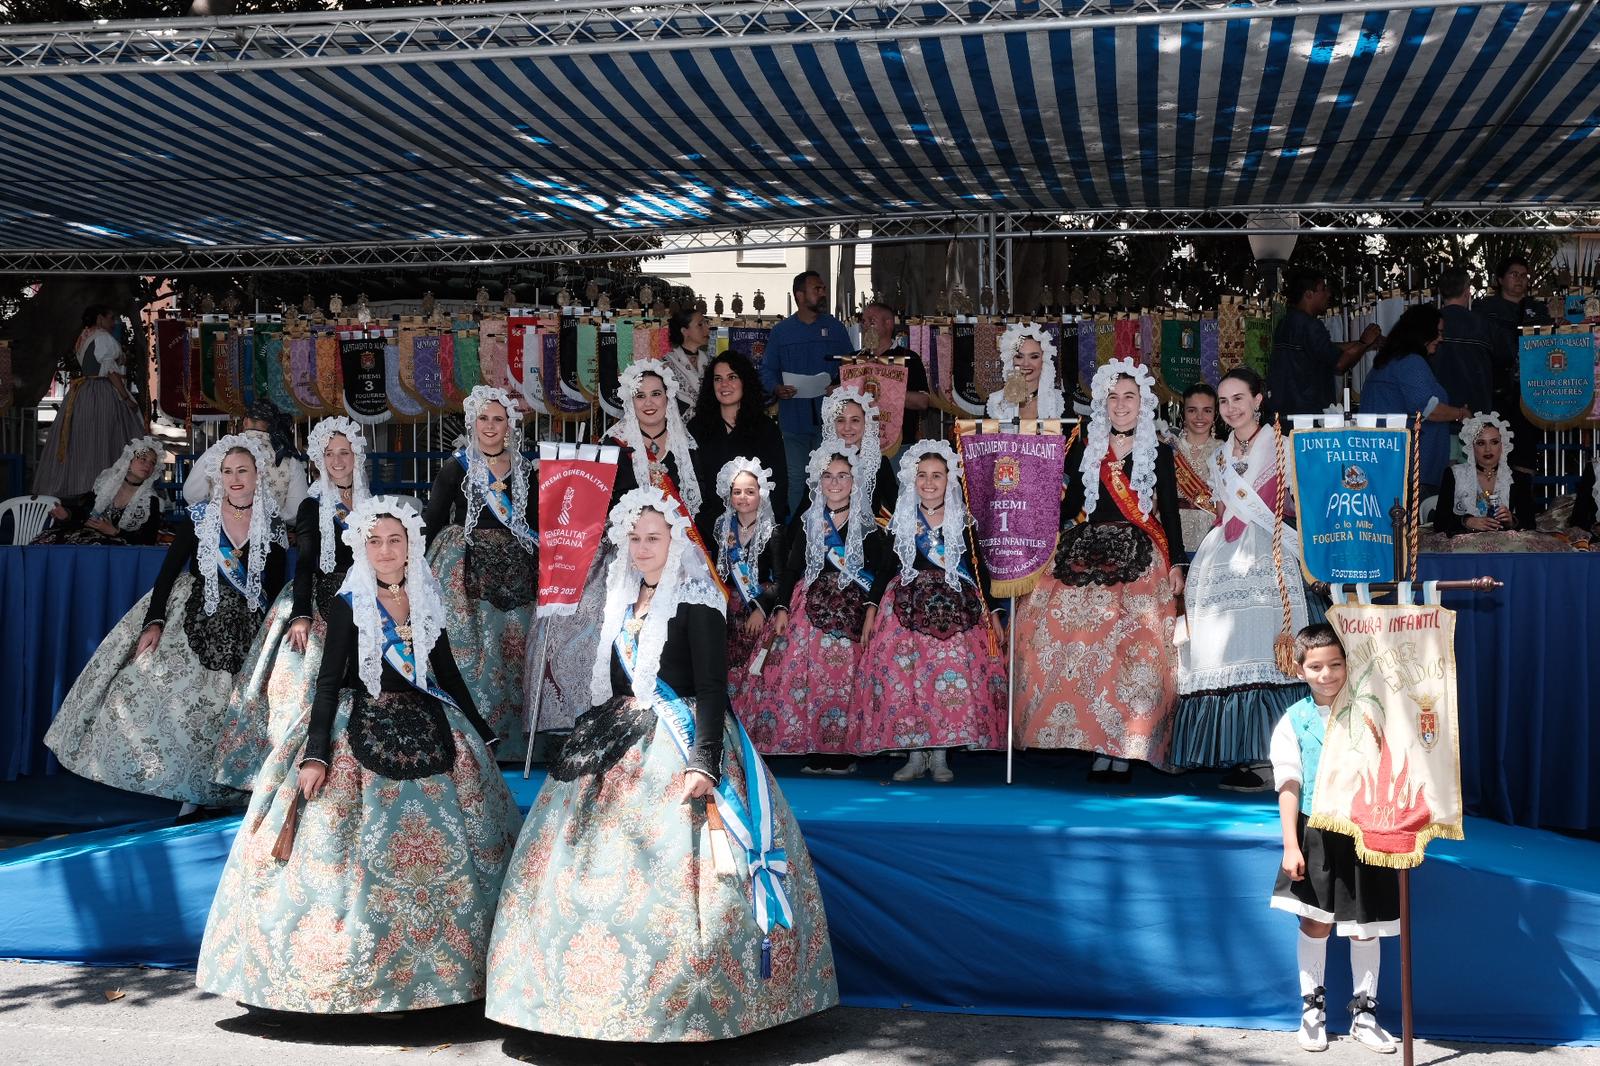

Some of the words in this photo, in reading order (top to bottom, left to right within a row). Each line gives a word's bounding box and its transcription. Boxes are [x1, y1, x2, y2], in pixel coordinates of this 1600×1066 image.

[364, 380, 374, 392] 3
[1527, 379, 1556, 388] MILLOR
[355, 392, 386, 400] FOGUERES
[1543, 388, 1583, 396] FOGUERES
[964, 441, 1009, 461] AJUNTAMENT
[1301, 438, 1341, 452] JUNTA
[1347, 437, 1400, 452] CENTRAL
[1327, 451, 1379, 464] FALLERA
[540, 473, 563, 491] PREMI
[562, 469, 609, 492] GENERALITAT
[990, 500, 1027, 510] PREMI
[1326, 493, 1382, 518] PREMI
[999, 512, 1009, 532] 1
[1002, 537, 1047, 548] INFANTILES
[1313, 532, 1354, 545] FOGUERA
[1359, 531, 1394, 545] INFANTIL
[1331, 569, 1368, 579] FOGUERES
[1388, 609, 1441, 633] INFANTIL
